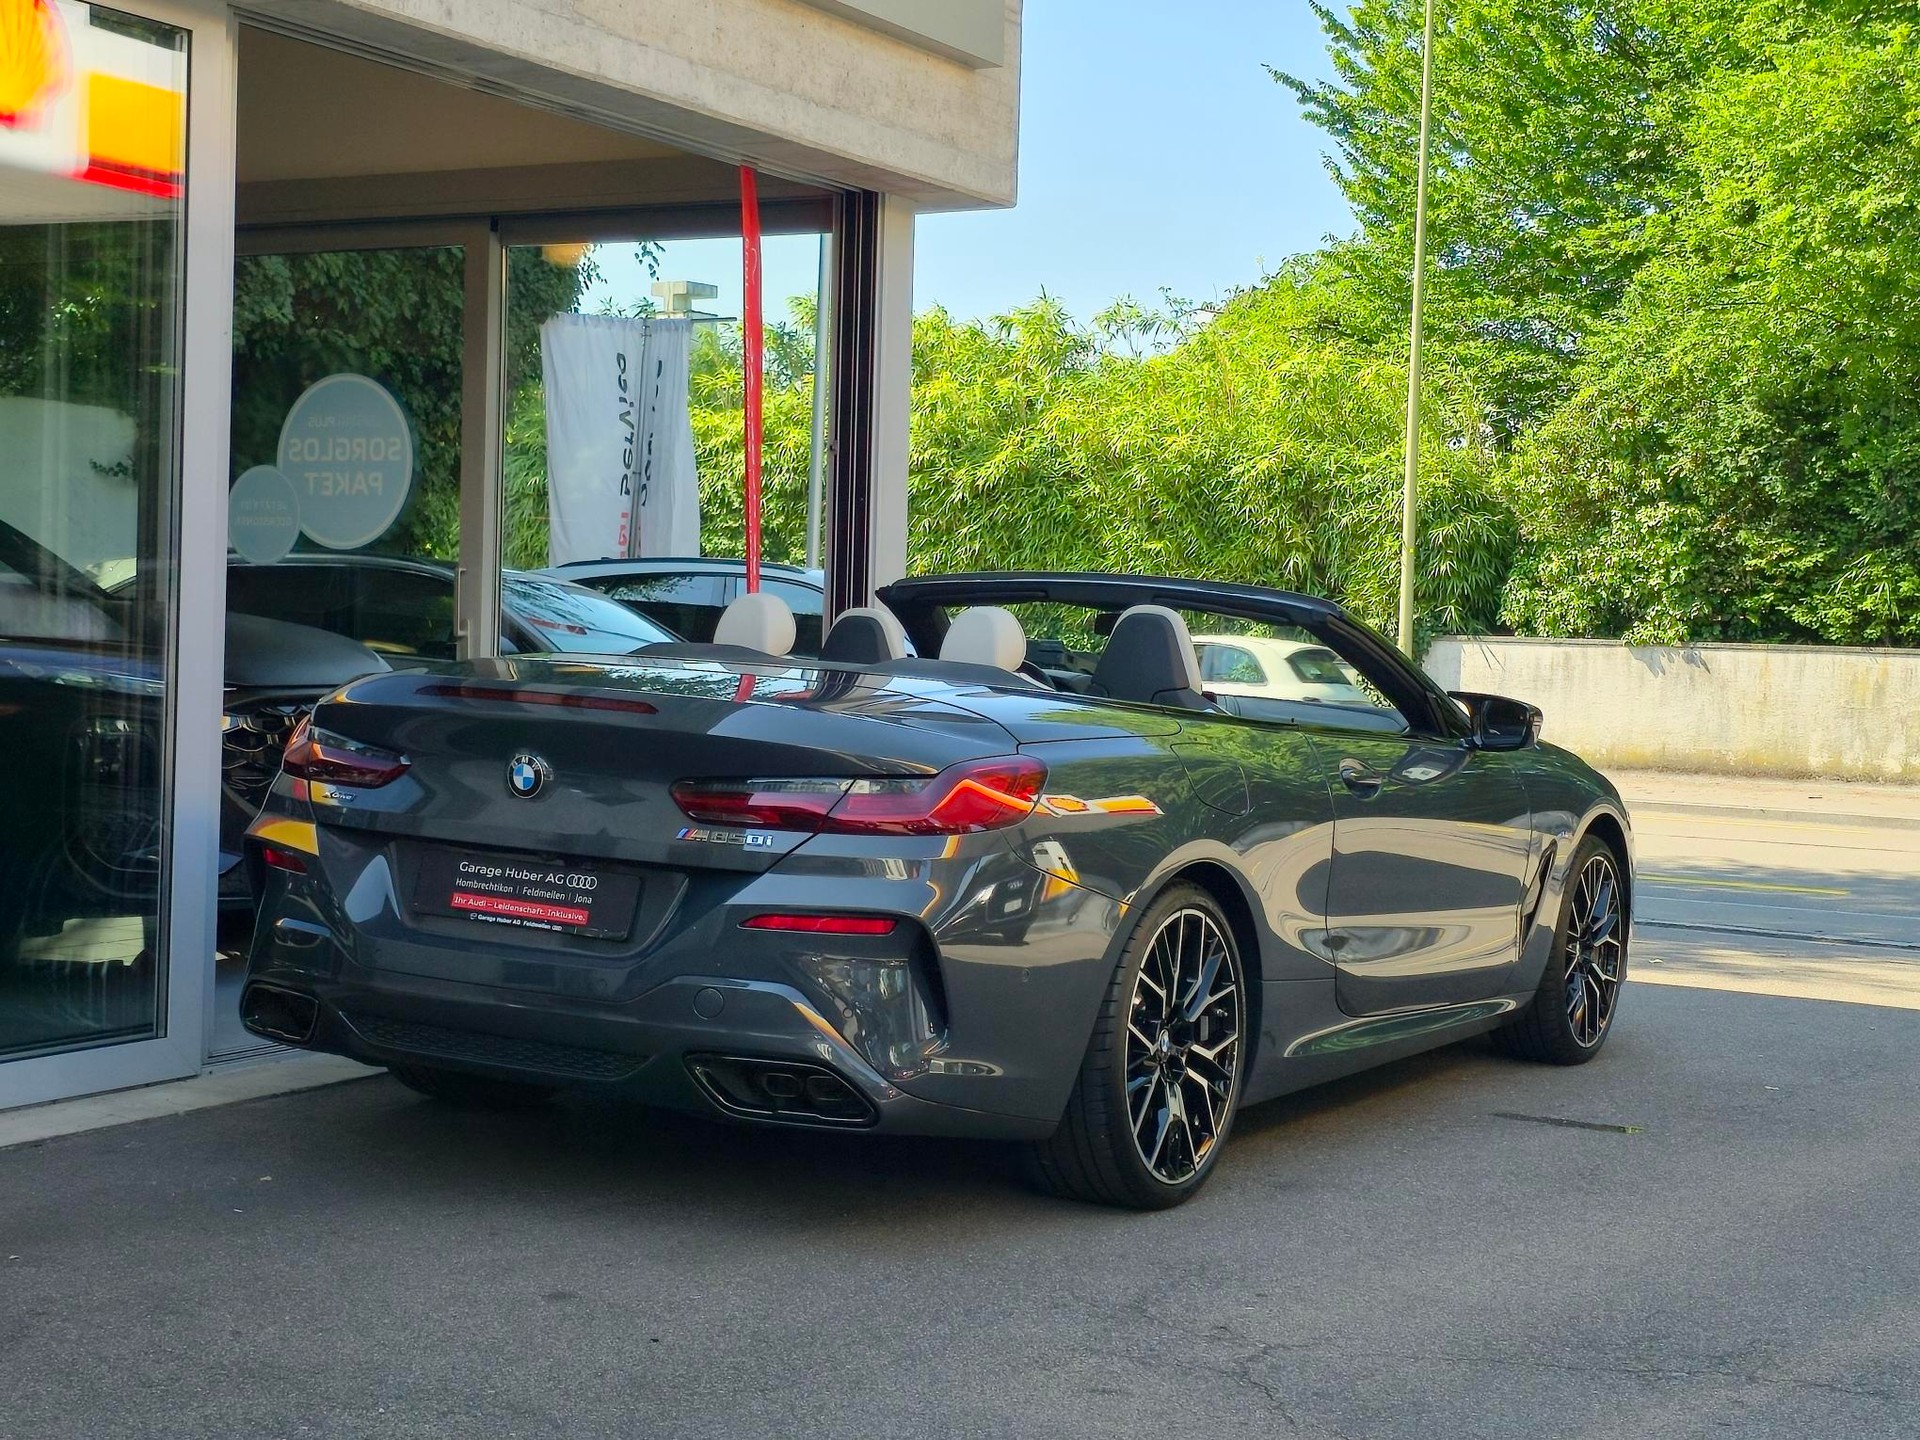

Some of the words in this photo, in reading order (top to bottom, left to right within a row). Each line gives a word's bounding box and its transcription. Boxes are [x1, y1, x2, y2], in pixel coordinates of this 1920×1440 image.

[460, 861, 502, 877] Garage
[505, 867, 543, 881] Huber
[545, 873, 564, 884] AG
[456, 878, 513, 893] Hombrechtikon
[522, 886, 565, 900] Feldmeilen
[574, 893, 592, 904] Jona
[468, 898, 487, 907] Audi
[547, 909, 585, 921] Inklusive.
